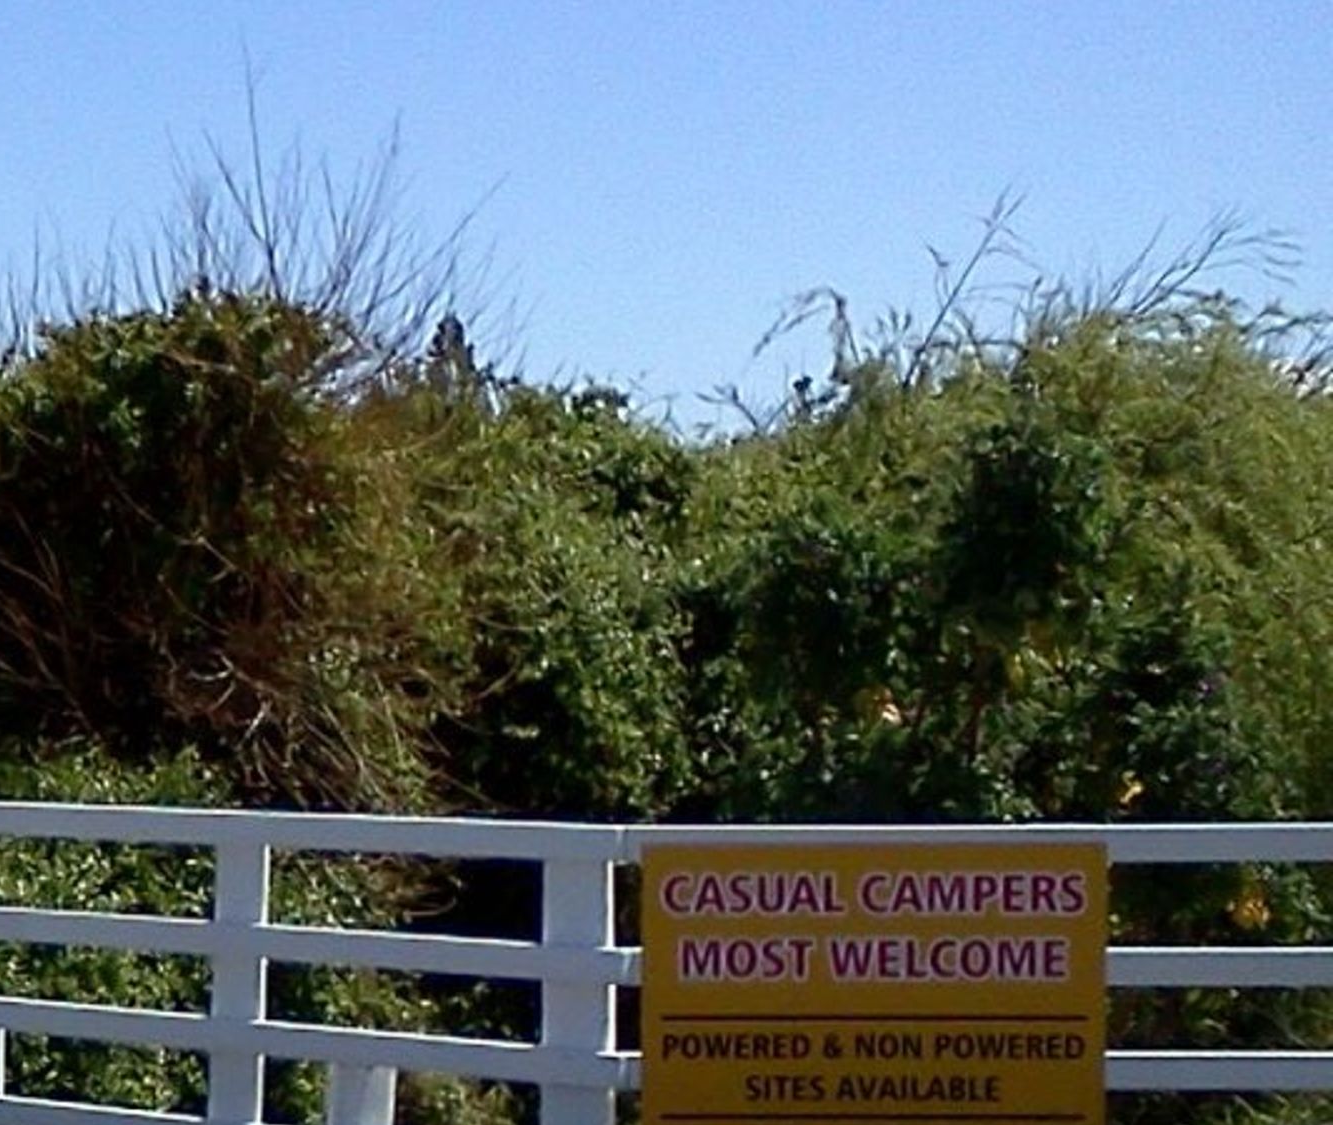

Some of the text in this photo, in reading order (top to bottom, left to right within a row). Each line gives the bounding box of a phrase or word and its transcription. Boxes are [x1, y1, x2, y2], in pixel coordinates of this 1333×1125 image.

[663, 873, 1085, 914] CASUAL CAMPERS
[680, 938, 1067, 979] MOST WELCOME
[663, 1032, 1086, 1060] POWERED & NON POWERED
[745, 1075, 1002, 1102] SITES AVAILABLE
